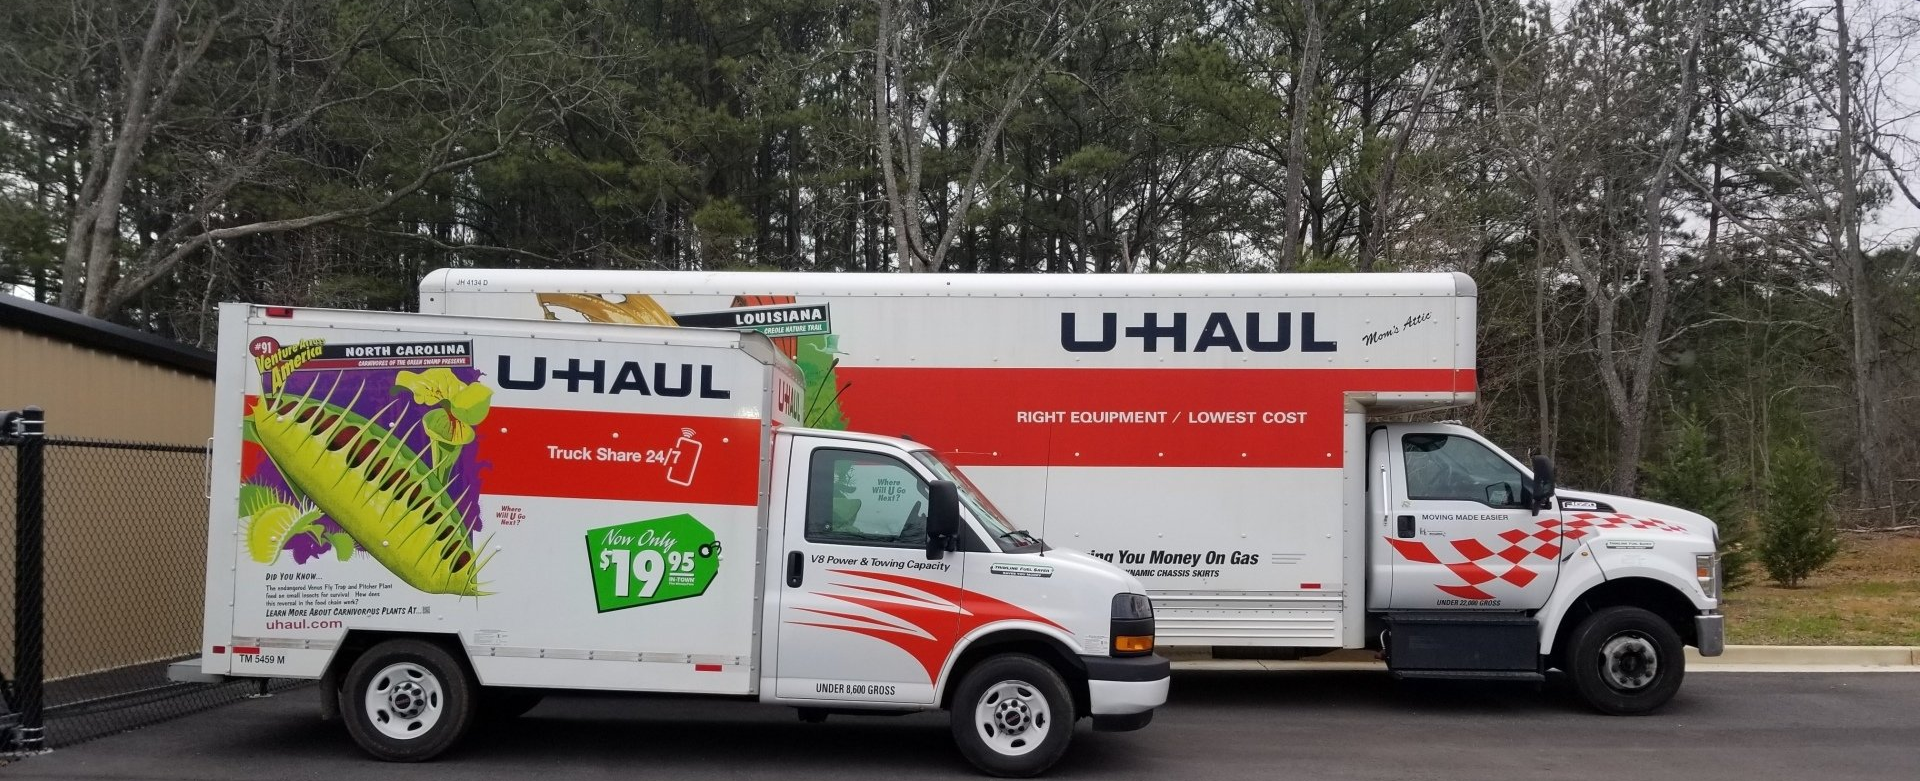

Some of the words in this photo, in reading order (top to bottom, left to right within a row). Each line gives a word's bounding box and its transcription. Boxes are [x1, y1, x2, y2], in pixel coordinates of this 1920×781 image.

[735, 308, 822, 325] LOUISIANA
[764, 326, 785, 334] CREOLE
[785, 325, 807, 333] NATURE
[1061, 312, 1338, 353] U-HAUL
[1362, 325, 1400, 346] Mom's
[1403, 312, 1431, 331] Attic
[254, 341, 272, 354] #91
[345, 345, 391, 357] NORTH
[396, 344, 466, 356] CAROLINA
[255, 344, 298, 375] Venture
[271, 345, 323, 397] America
[497, 354, 731, 400] U-HAUL
[1017, 411, 1066, 424] RIGHT
[1070, 411, 1168, 424] EQUIPMENT
[1188, 411, 1257, 424] LOWEST
[1262, 411, 1308, 424] COST
[547, 445, 592, 461] Truck
[596, 447, 641, 463] Share
[646, 449, 681, 466] 24/7
[877, 478, 901, 486] Where
[872, 486, 887, 494] Will
[887, 486, 895, 496] U
[896, 486, 906, 494] Go
[501, 505, 522, 513] Where
[509, 512, 517, 520] U
[601, 529, 635, 547] Now
[637, 529, 678, 552] Only
[811, 554, 825, 564] V8
[827, 555, 858, 566] Power
[860, 557, 869, 566] &
[871, 557, 905, 570] Towing
[907, 560, 950, 572] Capacity
[1118, 549, 1145, 565] You
[1149, 549, 1201, 568] Money
[1205, 550, 1226, 565] On
[1230, 550, 1259, 565] Gas
[265, 572, 278, 580] DID
[280, 572, 294, 580] YOU
[1157, 569, 1190, 577] CHASSIS
[1192, 569, 1220, 577] SKIRTS
[277, 584, 306, 592] endangered
[324, 583, 333, 591] Fly
[266, 608, 287, 618] LEARN
[288, 608, 308, 617] MORE
[309, 607, 333, 617] ABOUT
[333, 607, 380, 616] CARNIVOROUS
[381, 607, 407, 615] PLANTS
[266, 619, 343, 630] uhaul.com
[240, 654, 252, 664] TM
[254, 655, 275, 664] 5459
[277, 655, 285, 664] M
[816, 683, 844, 694] UNDER
[846, 684, 866, 695] 8,600
[868, 685, 896, 695] GROSS
